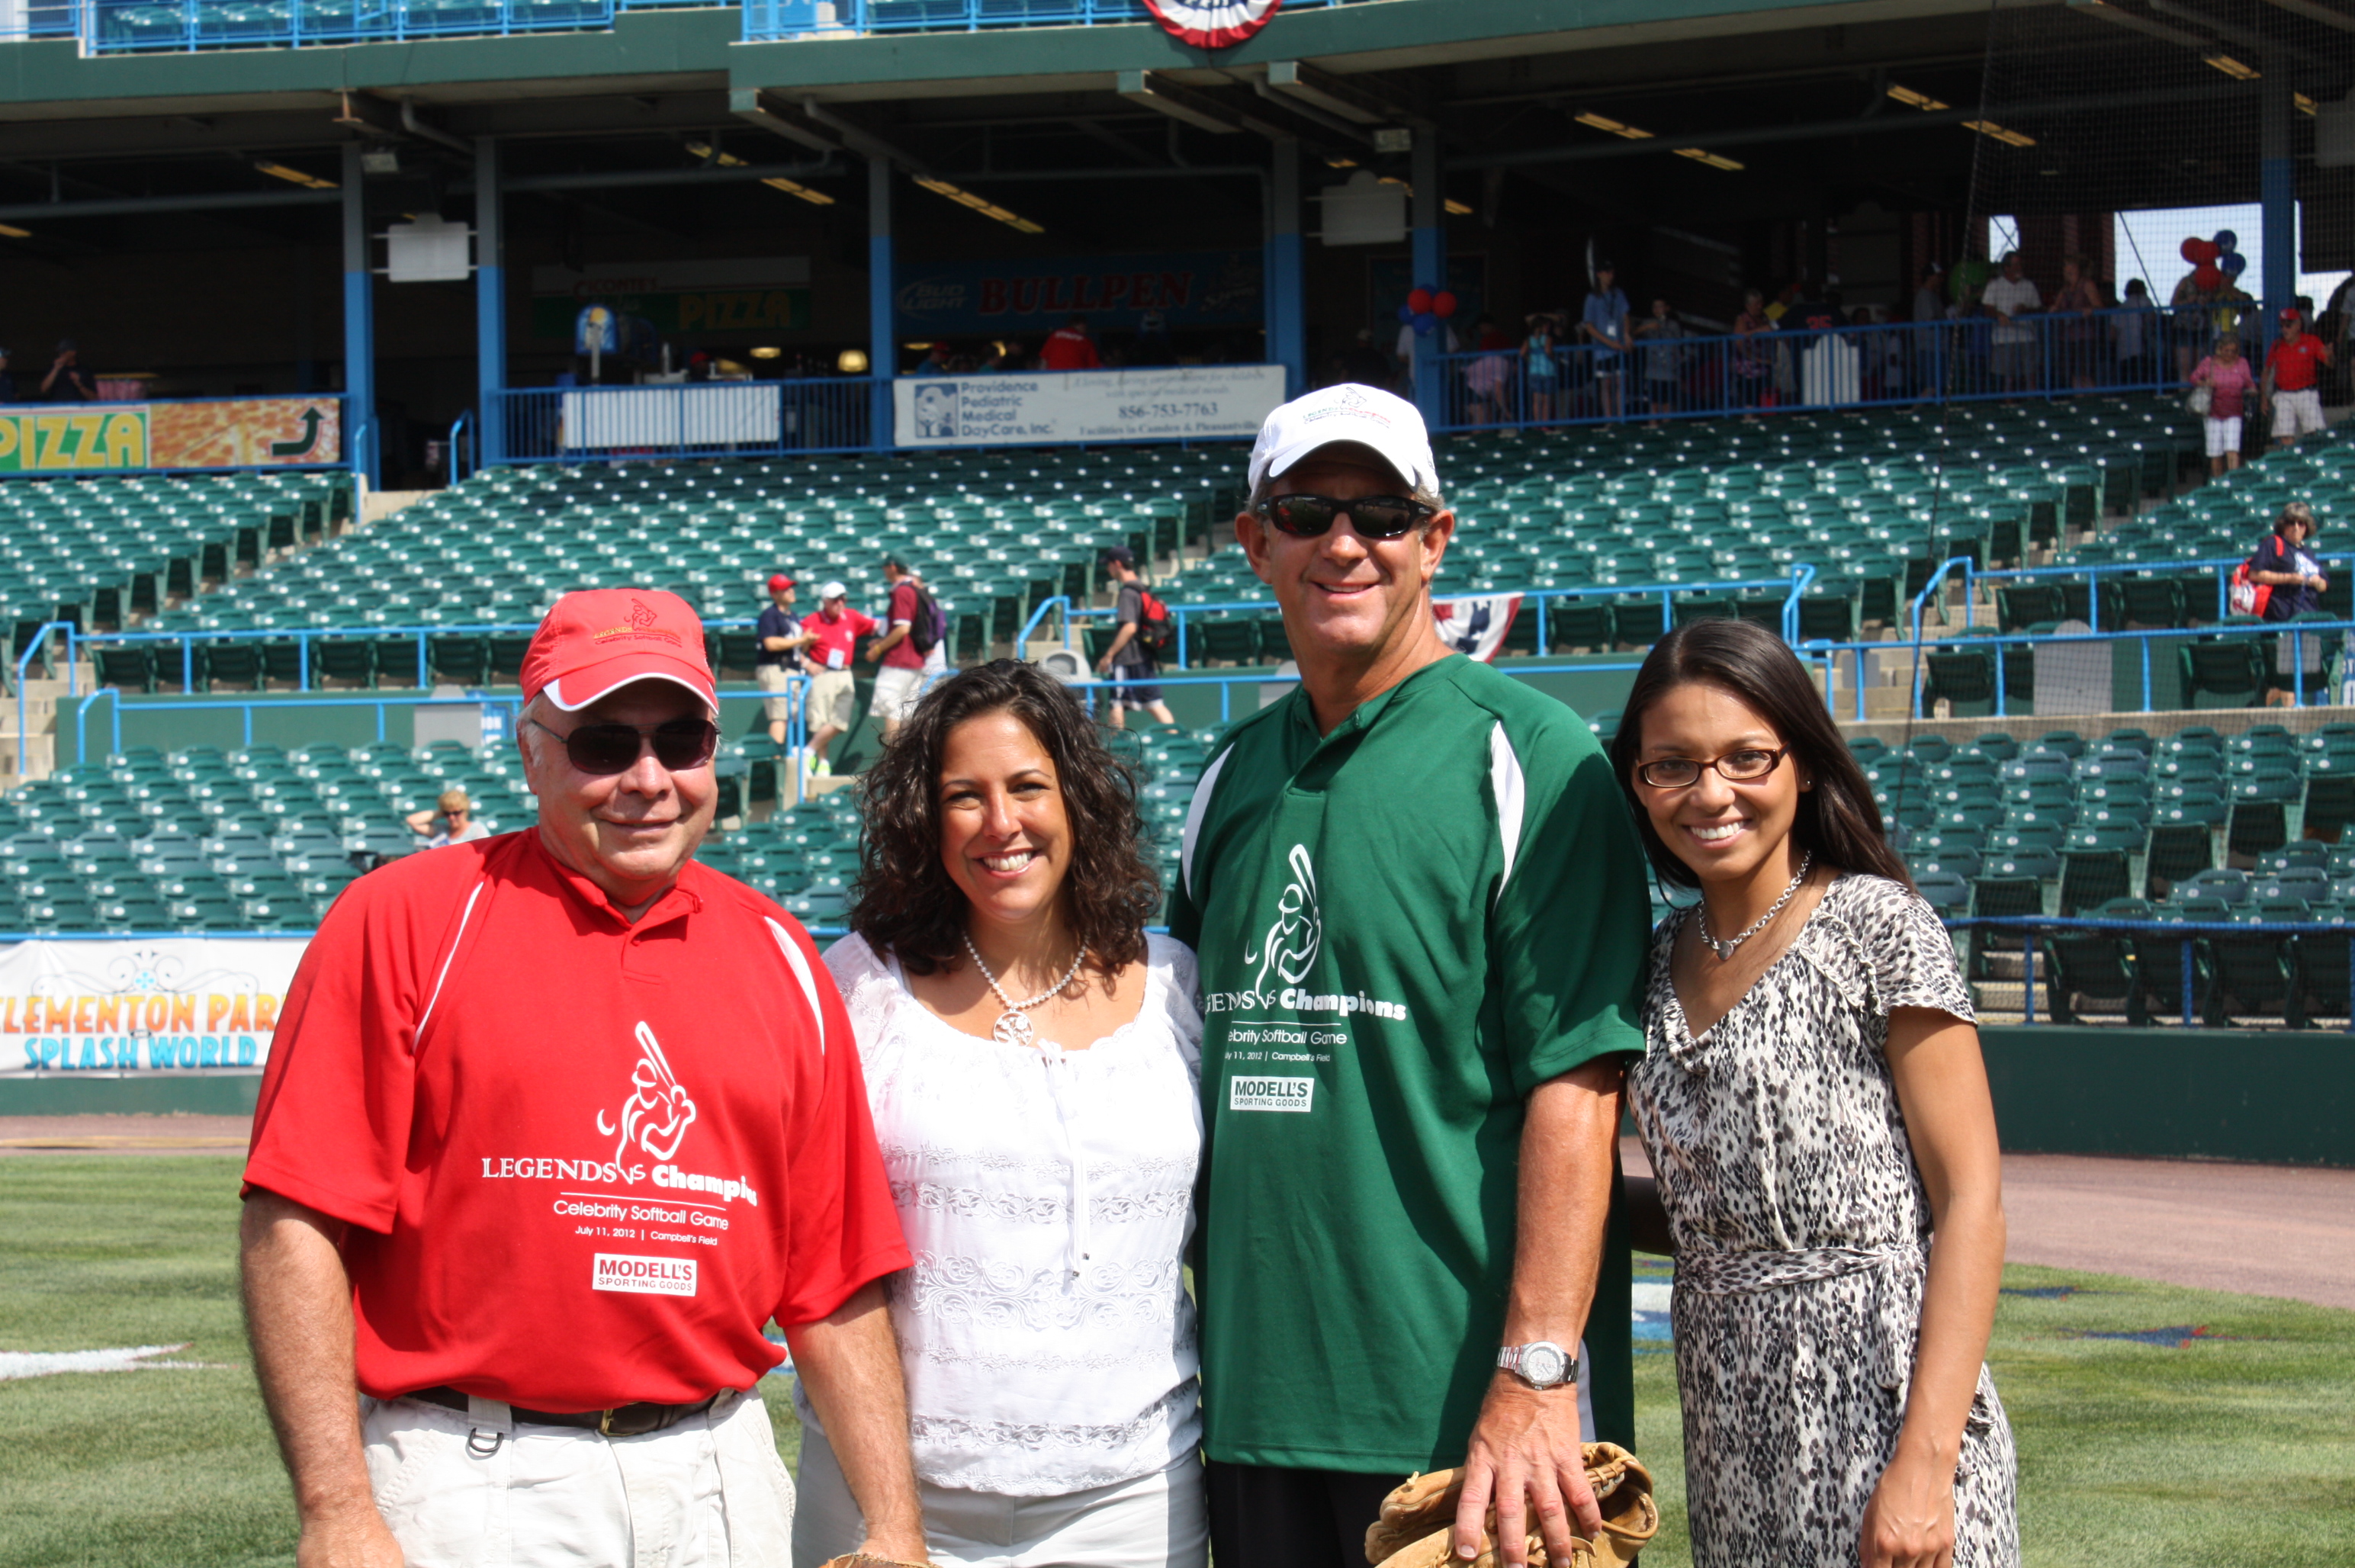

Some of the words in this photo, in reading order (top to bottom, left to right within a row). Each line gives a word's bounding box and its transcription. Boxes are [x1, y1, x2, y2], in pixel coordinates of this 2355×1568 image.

[978, 271, 1195, 316] BULLPEN
[677, 290, 793, 329] PIZZA
[961, 381, 1039, 393] Providence
[961, 395, 1023, 407] Pediatric
[962, 410, 1017, 422] Medical
[1118, 402, 1219, 419] 856-753-7763
[1139, 423, 1181, 434] Camden
[593, 626, 633, 638] LEGENDS
[1280, 988, 1406, 1020] Champions
[0, 994, 197, 1034] LEMENTON
[207, 994, 288, 1033] PAR
[1261, 1029, 1307, 1045] Softball
[1310, 1030, 1348, 1045] Game
[24, 1036, 139, 1069] SPLASH
[148, 1036, 258, 1068] WORLD
[1234, 1052, 1245, 1060] 11,
[1247, 1052, 1263, 1060] 2012
[1271, 1052, 1315, 1062] Campbell's
[1316, 1053, 1330, 1062] Field
[1234, 1080, 1308, 1097] MODELL'S
[1234, 1097, 1274, 1107] SPORTING
[1275, 1098, 1307, 1107] GOODS
[481, 1157, 618, 1183] LEGENDS
[553, 1200, 628, 1222] Celebrity
[631, 1205, 686, 1224] Softball
[689, 1211, 729, 1230] Game
[575, 1225, 593, 1237] July
[596, 1226, 610, 1237] 11,
[613, 1227, 635, 1238] 2012
[650, 1230, 696, 1244] Campbell's
[698, 1235, 718, 1246] Field
[599, 1258, 692, 1281] MODELL'S
[598, 1277, 657, 1289] SPORTING
[659, 1280, 692, 1291] GOODS
